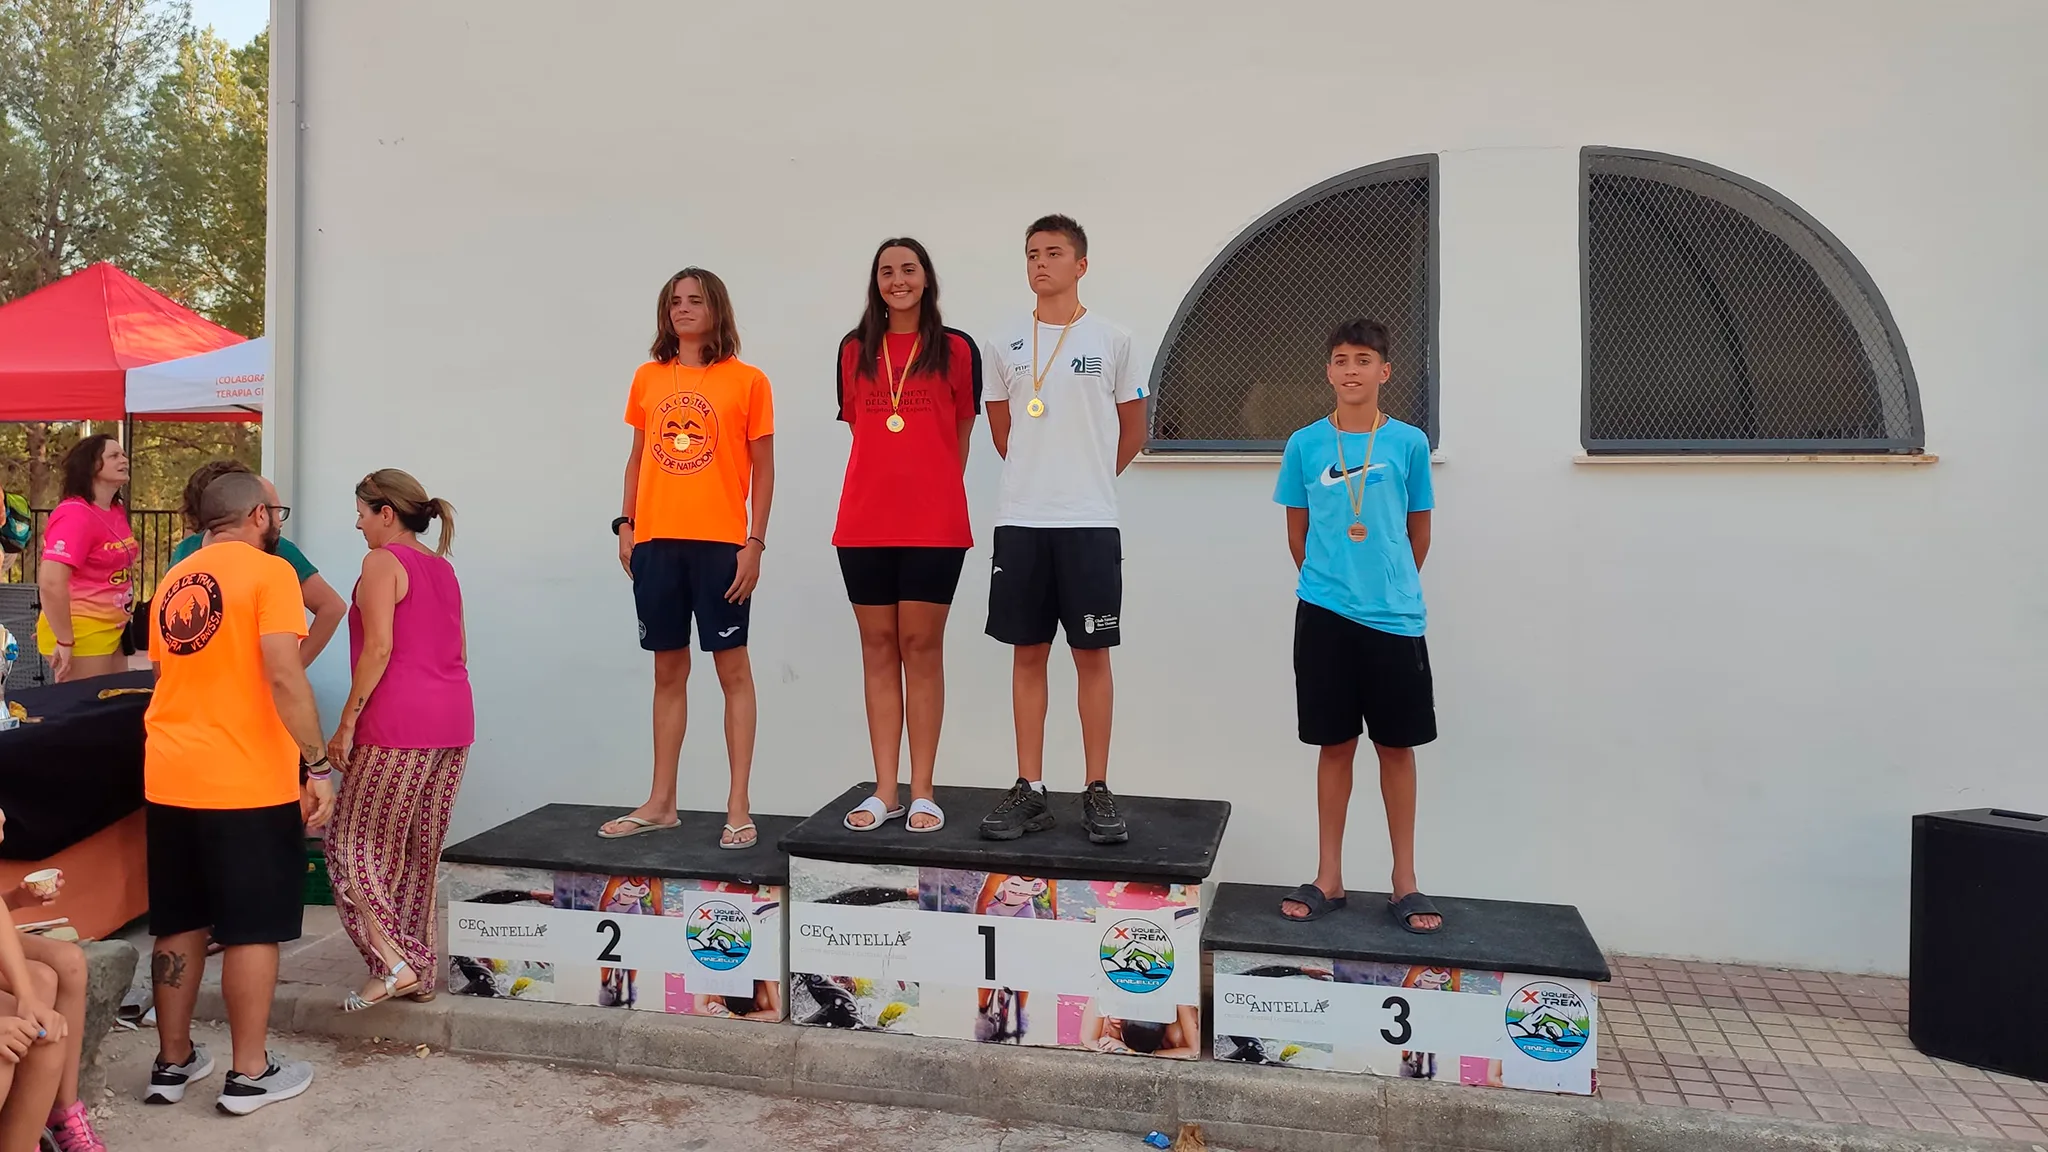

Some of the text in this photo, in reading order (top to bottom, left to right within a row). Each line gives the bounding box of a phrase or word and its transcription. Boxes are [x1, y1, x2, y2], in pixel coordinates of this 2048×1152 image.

[216, 389, 252, 398] TERAPIA
[660, 403, 672, 413] LA
[663, 458, 676, 469] DE
[181, 574, 197, 587] DE
[196, 573, 216, 593] TRAIL
[699, 908, 713, 920] X
[458, 919, 486, 930] CEC
[800, 924, 833, 938] CEC
[1114, 927, 1130, 940] X
[1132, 933, 1167, 941] TREM
[596, 919, 622, 962] 2
[978, 926, 996, 980] 1
[1224, 992, 1256, 1005] CEC
[1521, 990, 1539, 1004] X
[1542, 998, 1581, 1008] TREM
[1380, 996, 1412, 1045] 3
